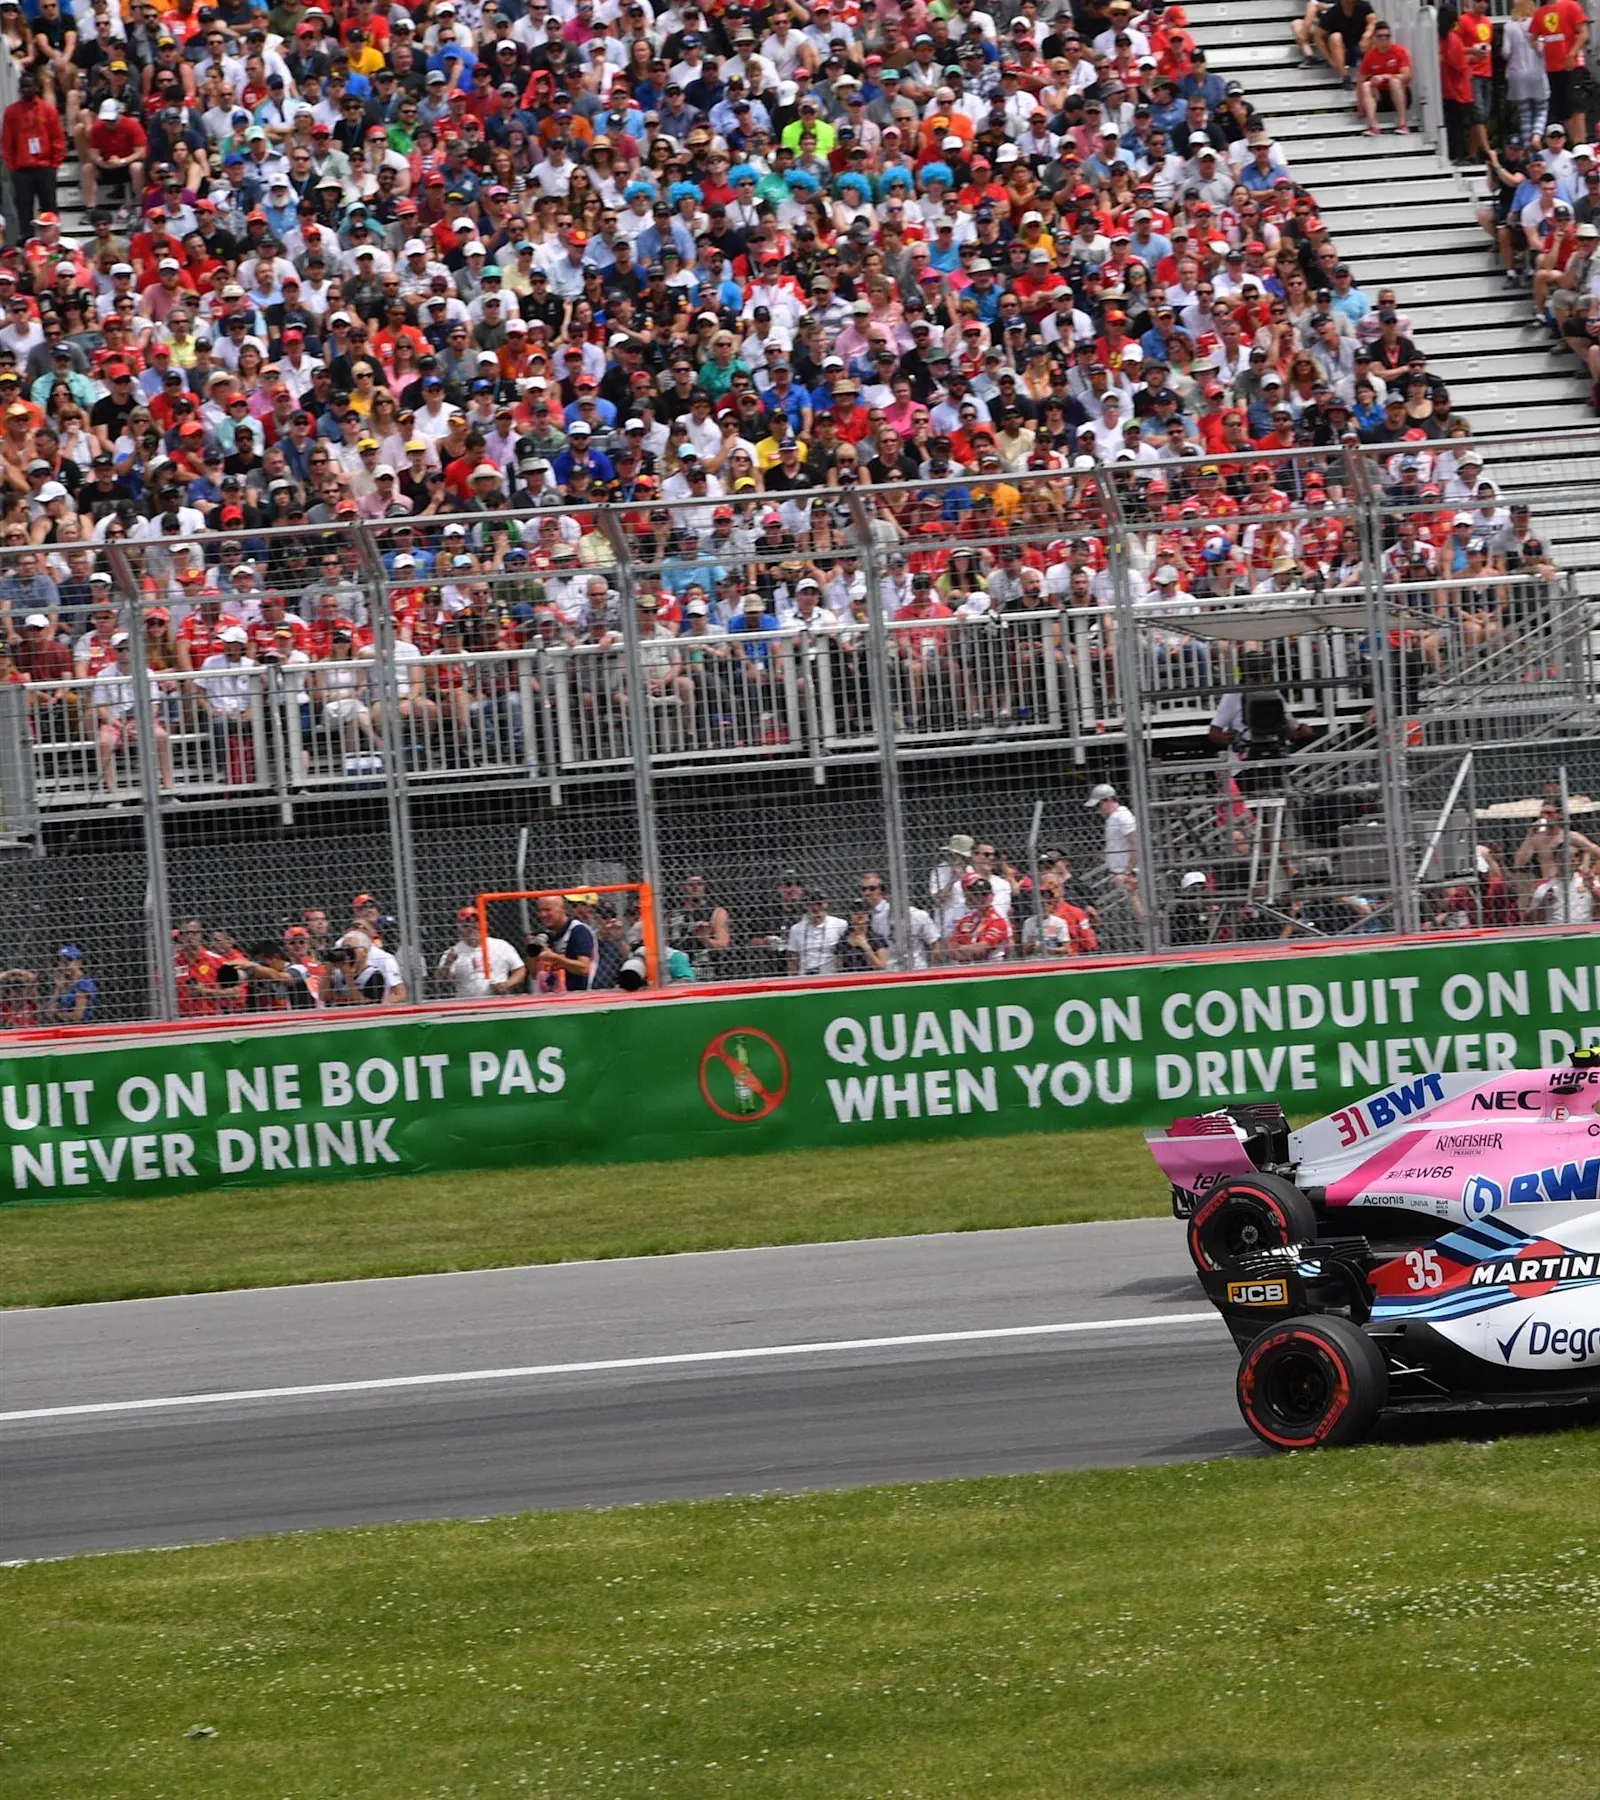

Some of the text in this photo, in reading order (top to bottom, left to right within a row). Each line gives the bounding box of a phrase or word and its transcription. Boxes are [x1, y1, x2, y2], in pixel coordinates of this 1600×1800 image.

[825, 1004, 1034, 1067] QUAND
[1055, 996, 1143, 1046] ON
[1161, 976, 1419, 1040] CONDUIT
[1442, 970, 1530, 1021] ON
[2, 1046, 566, 1131] UIT ON NE BOIT PAS
[827, 1066, 998, 1123] WHEN
[1014, 1057, 1133, 1108] YOU
[1156, 1045, 1317, 1100] DRIVE
[1338, 1031, 1518, 1087] NEVER
[1549, 1071, 1600, 1086] HYPE
[1366, 1073, 1445, 1129] BWT
[1471, 1090, 1541, 1111] NEC
[1555, 1107, 1565, 1121] E
[1331, 1106, 1370, 1148] 31
[1436, 1132, 1503, 1151] KINGFISHER
[12, 1118, 400, 1189] NEVER DRINK
[1362, 1194, 1405, 1205] Acronis
[1405, 1249, 1443, 1290] 35
[1232, 1284, 1284, 1303] JCB
